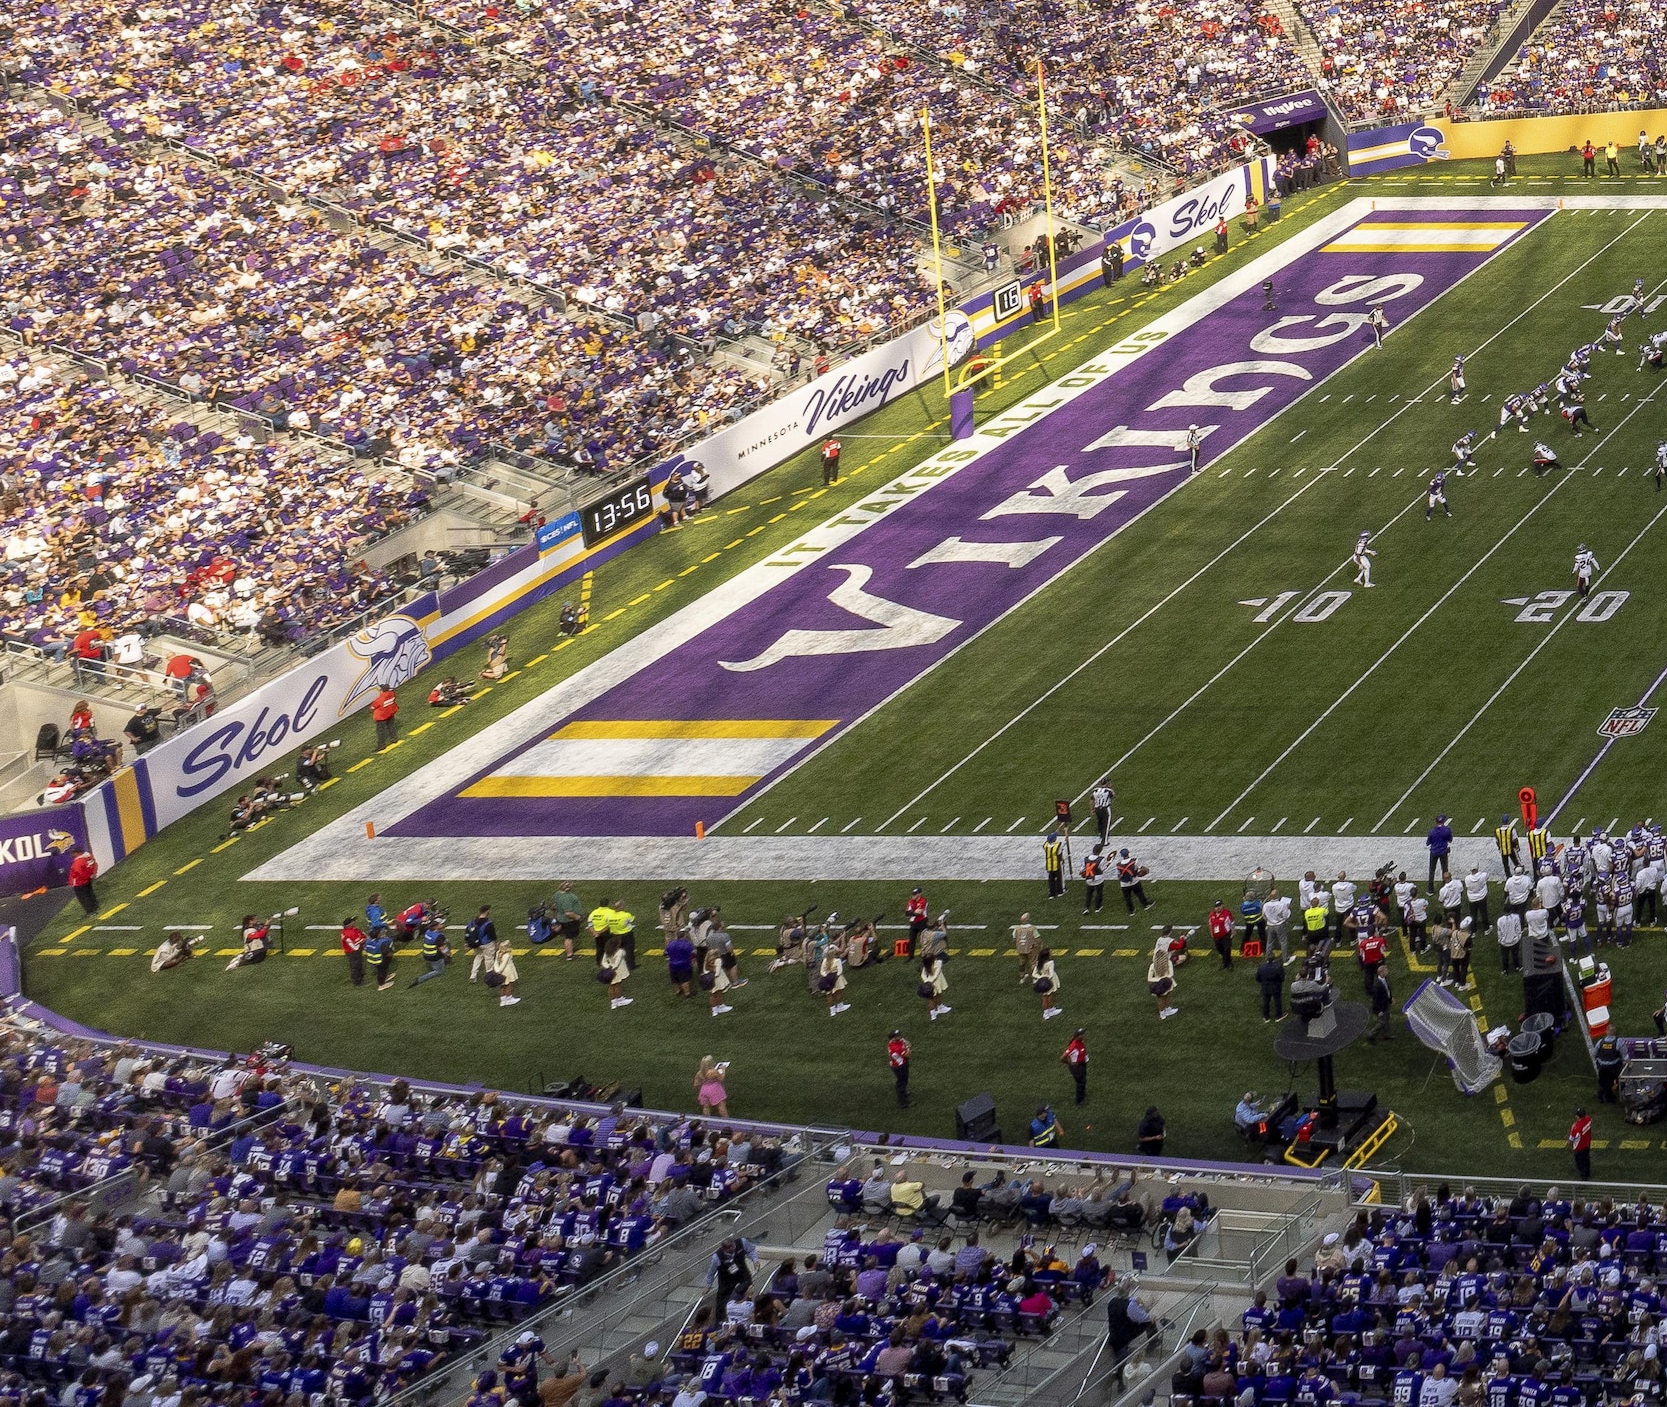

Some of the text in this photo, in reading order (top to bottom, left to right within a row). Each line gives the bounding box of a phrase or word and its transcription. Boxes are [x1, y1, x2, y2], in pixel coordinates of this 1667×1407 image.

[1169, 184, 1235, 239] Skol
[1003, 286, 1019, 309] 16
[738, 359, 911, 461] MINNESOTA Vikings
[717, 270, 1426, 675] VIKINGS
[763, 330, 1169, 568] IT TAKES ALL OF US
[546, 520, 580, 542] CBS NFL
[593, 484, 651, 534] 13:56
[1253, 589, 1353, 624] 10
[1513, 589, 1632, 624] 20
[175, 674, 329, 797] Skol
[1602, 719, 1642, 735] NFL
